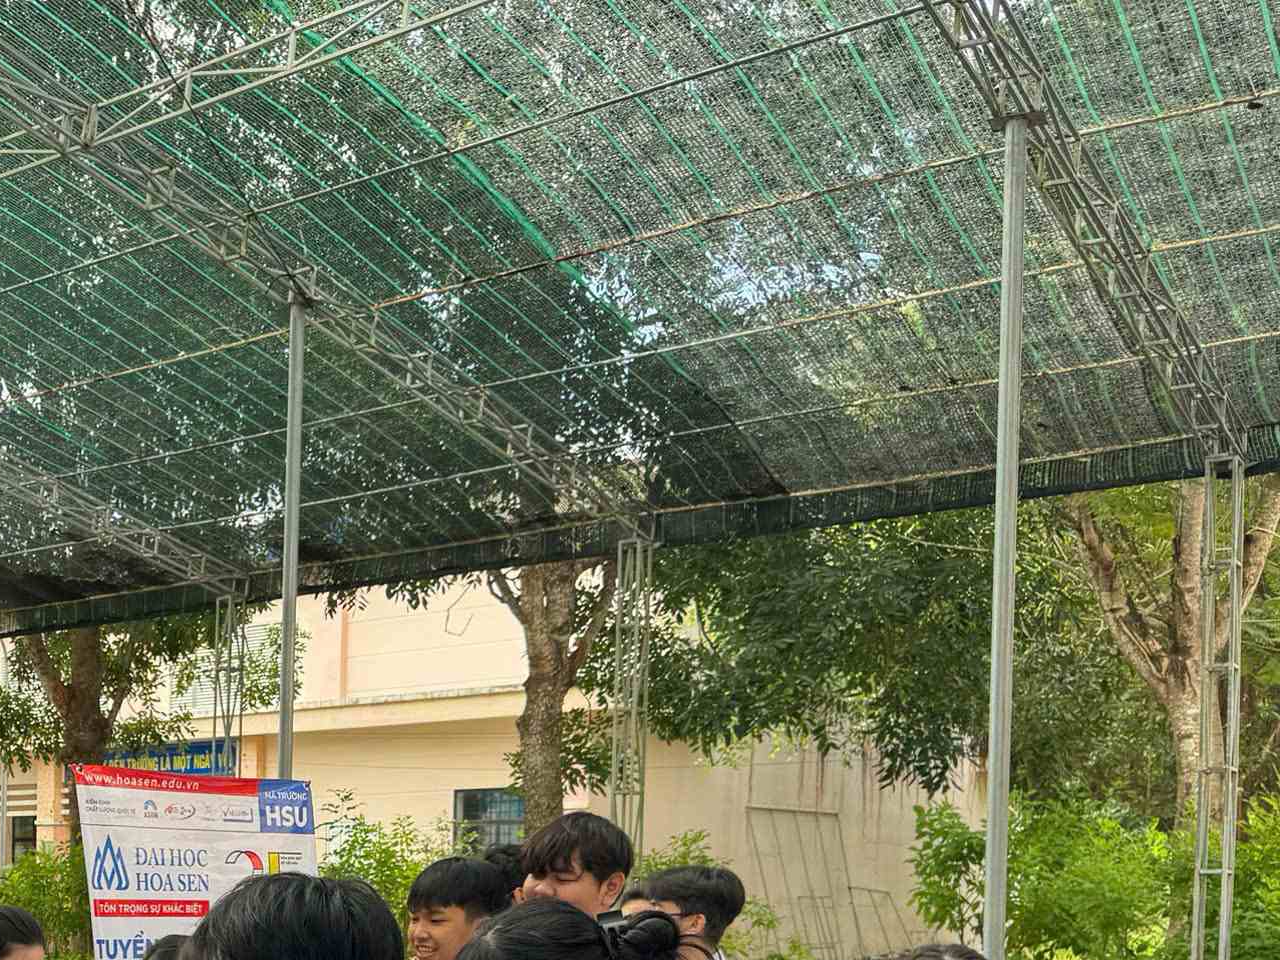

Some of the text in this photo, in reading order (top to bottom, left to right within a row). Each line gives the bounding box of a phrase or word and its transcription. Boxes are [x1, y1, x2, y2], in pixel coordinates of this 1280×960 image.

[84, 773, 200, 791] www.hoasen.edu.vn
[266, 806, 307, 828] HSU
[136, 847, 208, 868] ĐẠI HỌC
[136, 873, 208, 891] HOA SEN
